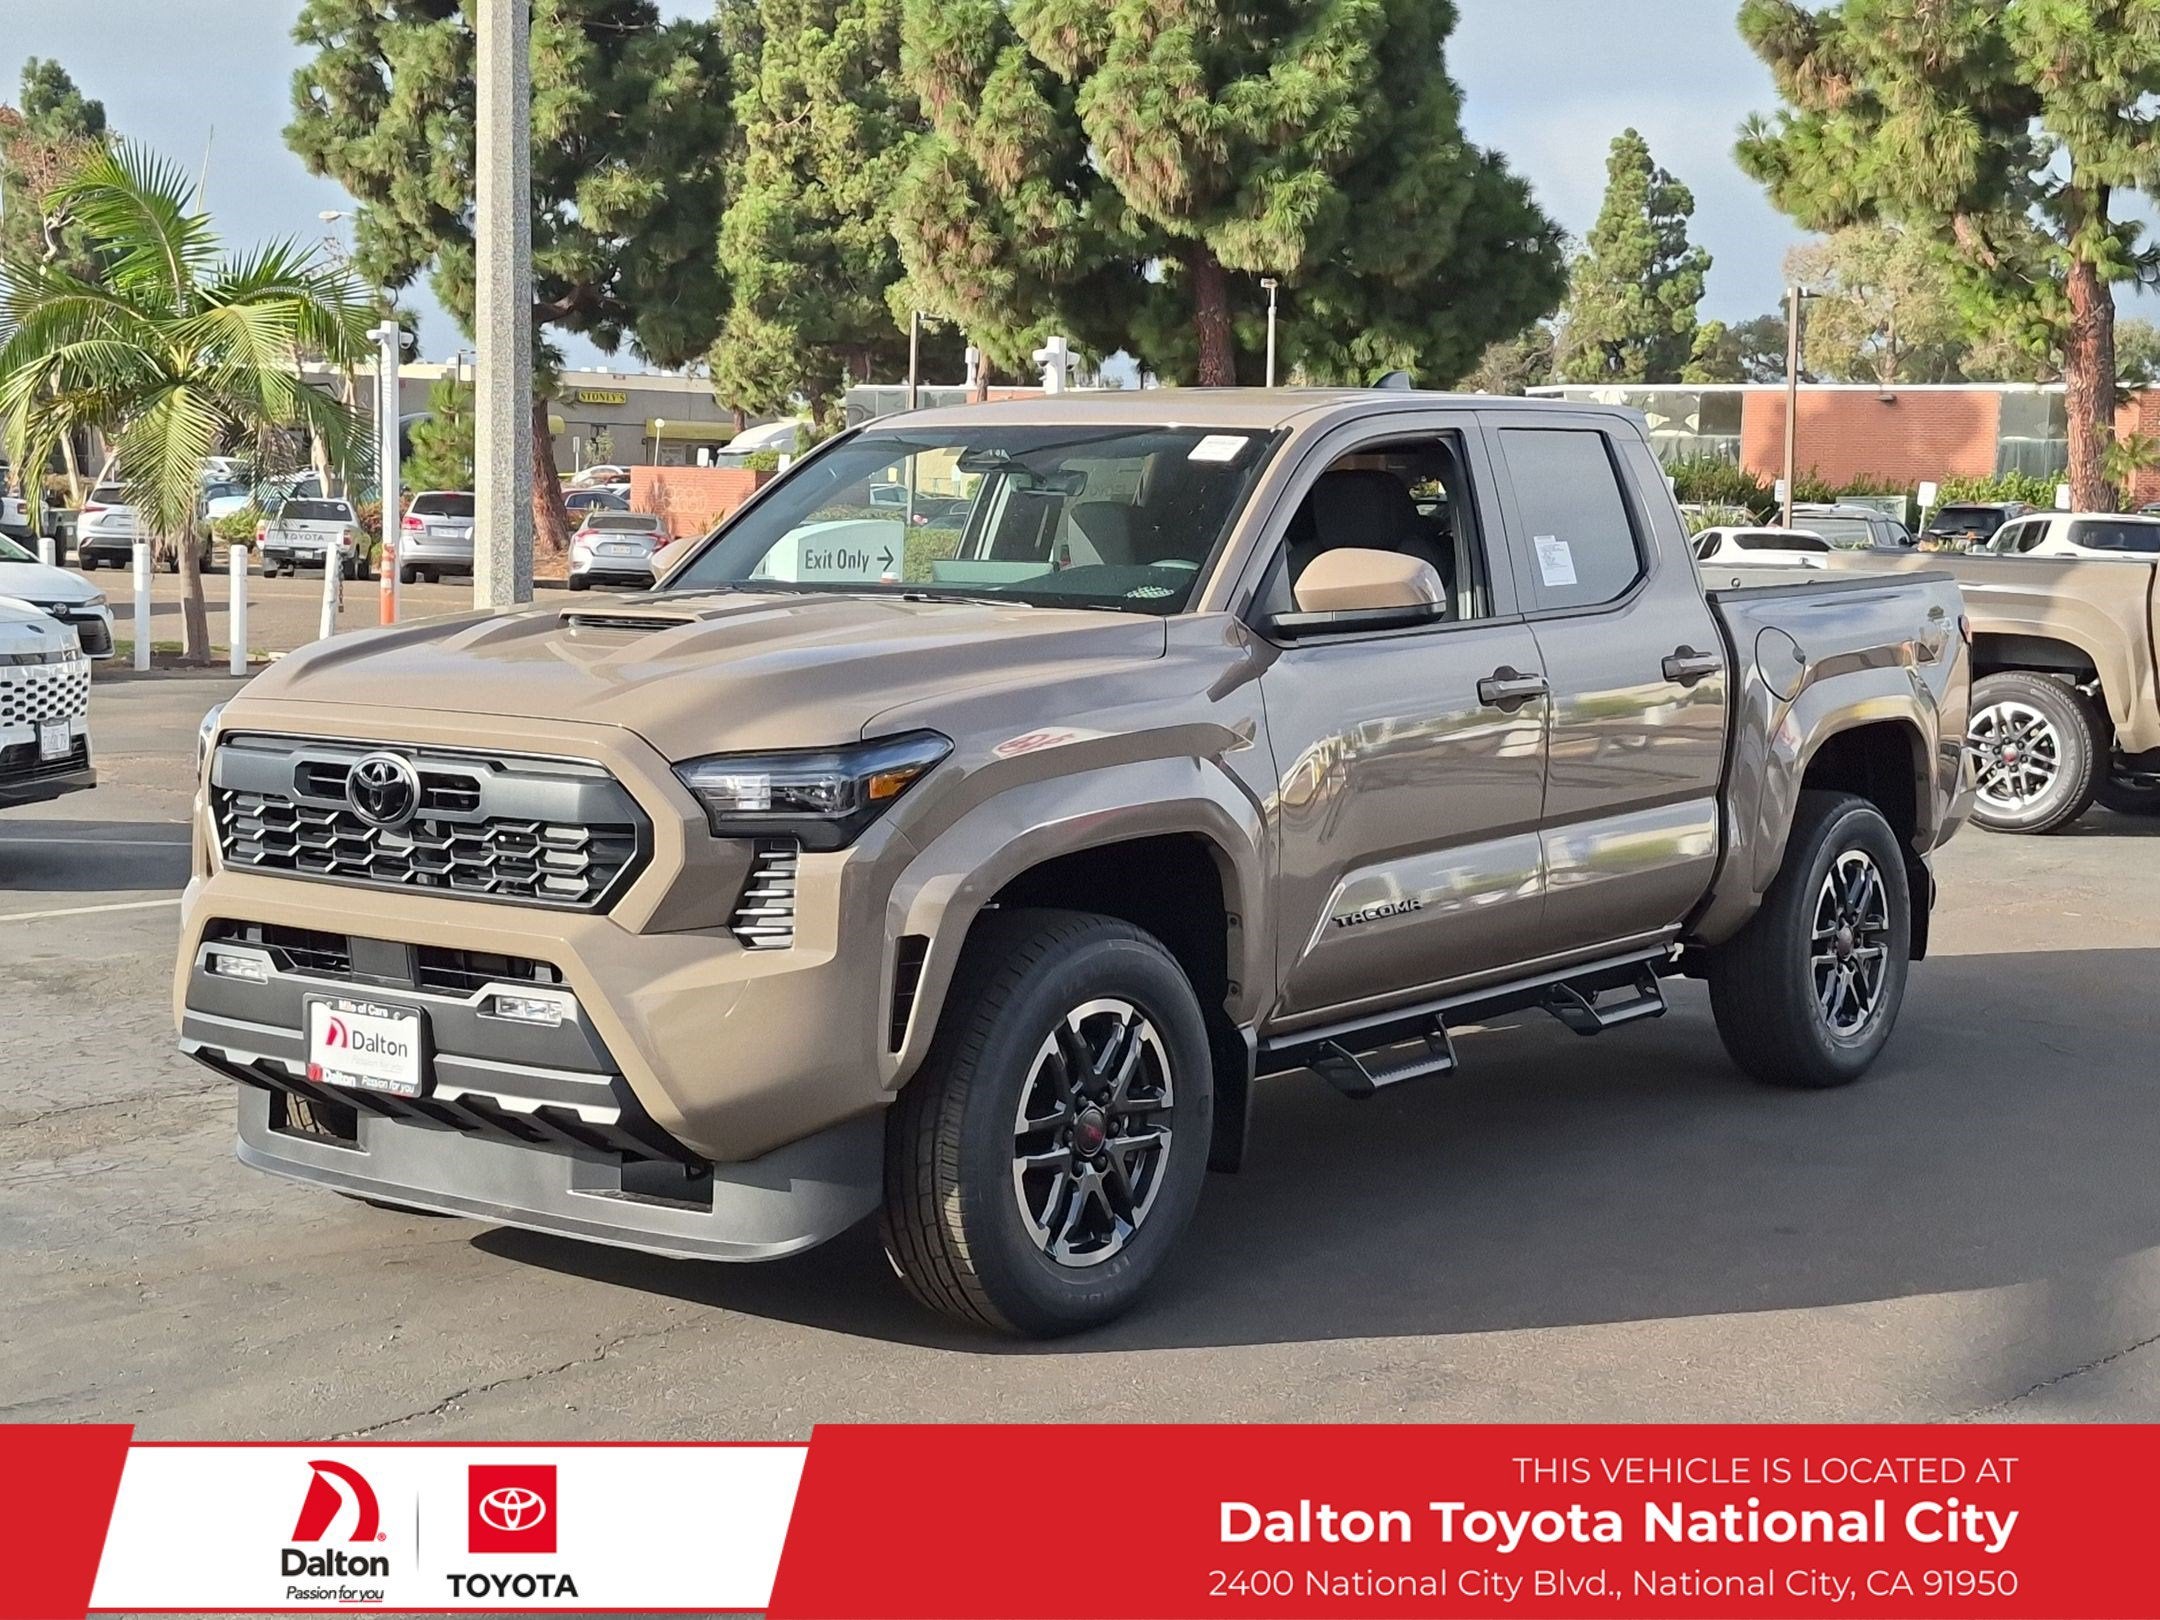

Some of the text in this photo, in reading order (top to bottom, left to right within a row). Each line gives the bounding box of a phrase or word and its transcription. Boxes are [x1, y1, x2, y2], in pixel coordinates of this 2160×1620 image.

[284, 532, 325, 541] TOYOTA
[805, 548, 869, 573] Exit Only
[1331, 899, 1425, 928] TACOMA
[357, 1003, 367, 1014] of
[352, 1030, 408, 1058] Dalton
[323, 1068, 357, 1088] Dalton
[361, 1075, 415, 1094] Passion for you
